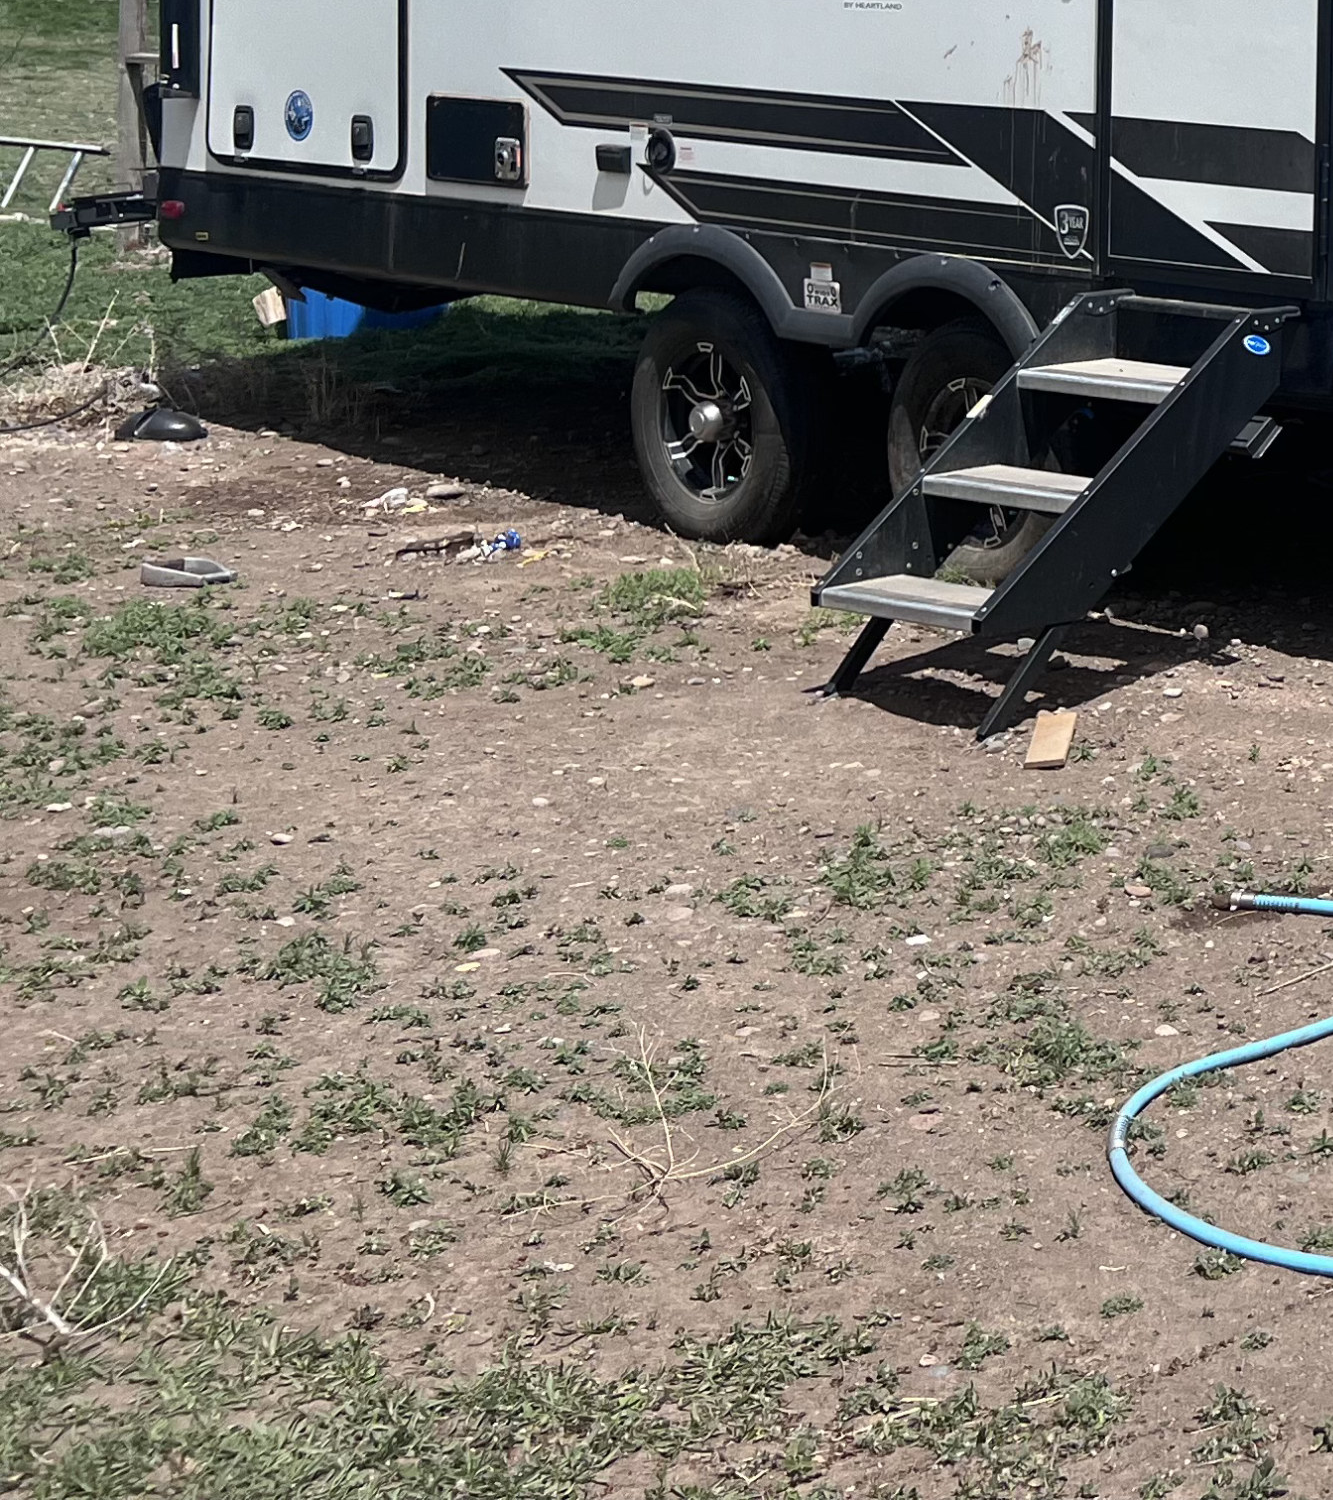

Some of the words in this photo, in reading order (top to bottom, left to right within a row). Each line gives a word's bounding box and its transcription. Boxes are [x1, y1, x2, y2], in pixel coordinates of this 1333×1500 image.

[855, 2, 902, 10] HEARTLAND
[1060, 211, 1069, 235] 3
[1069, 216, 1084, 229] YEAR
[806, 294, 838, 308] TRAX
